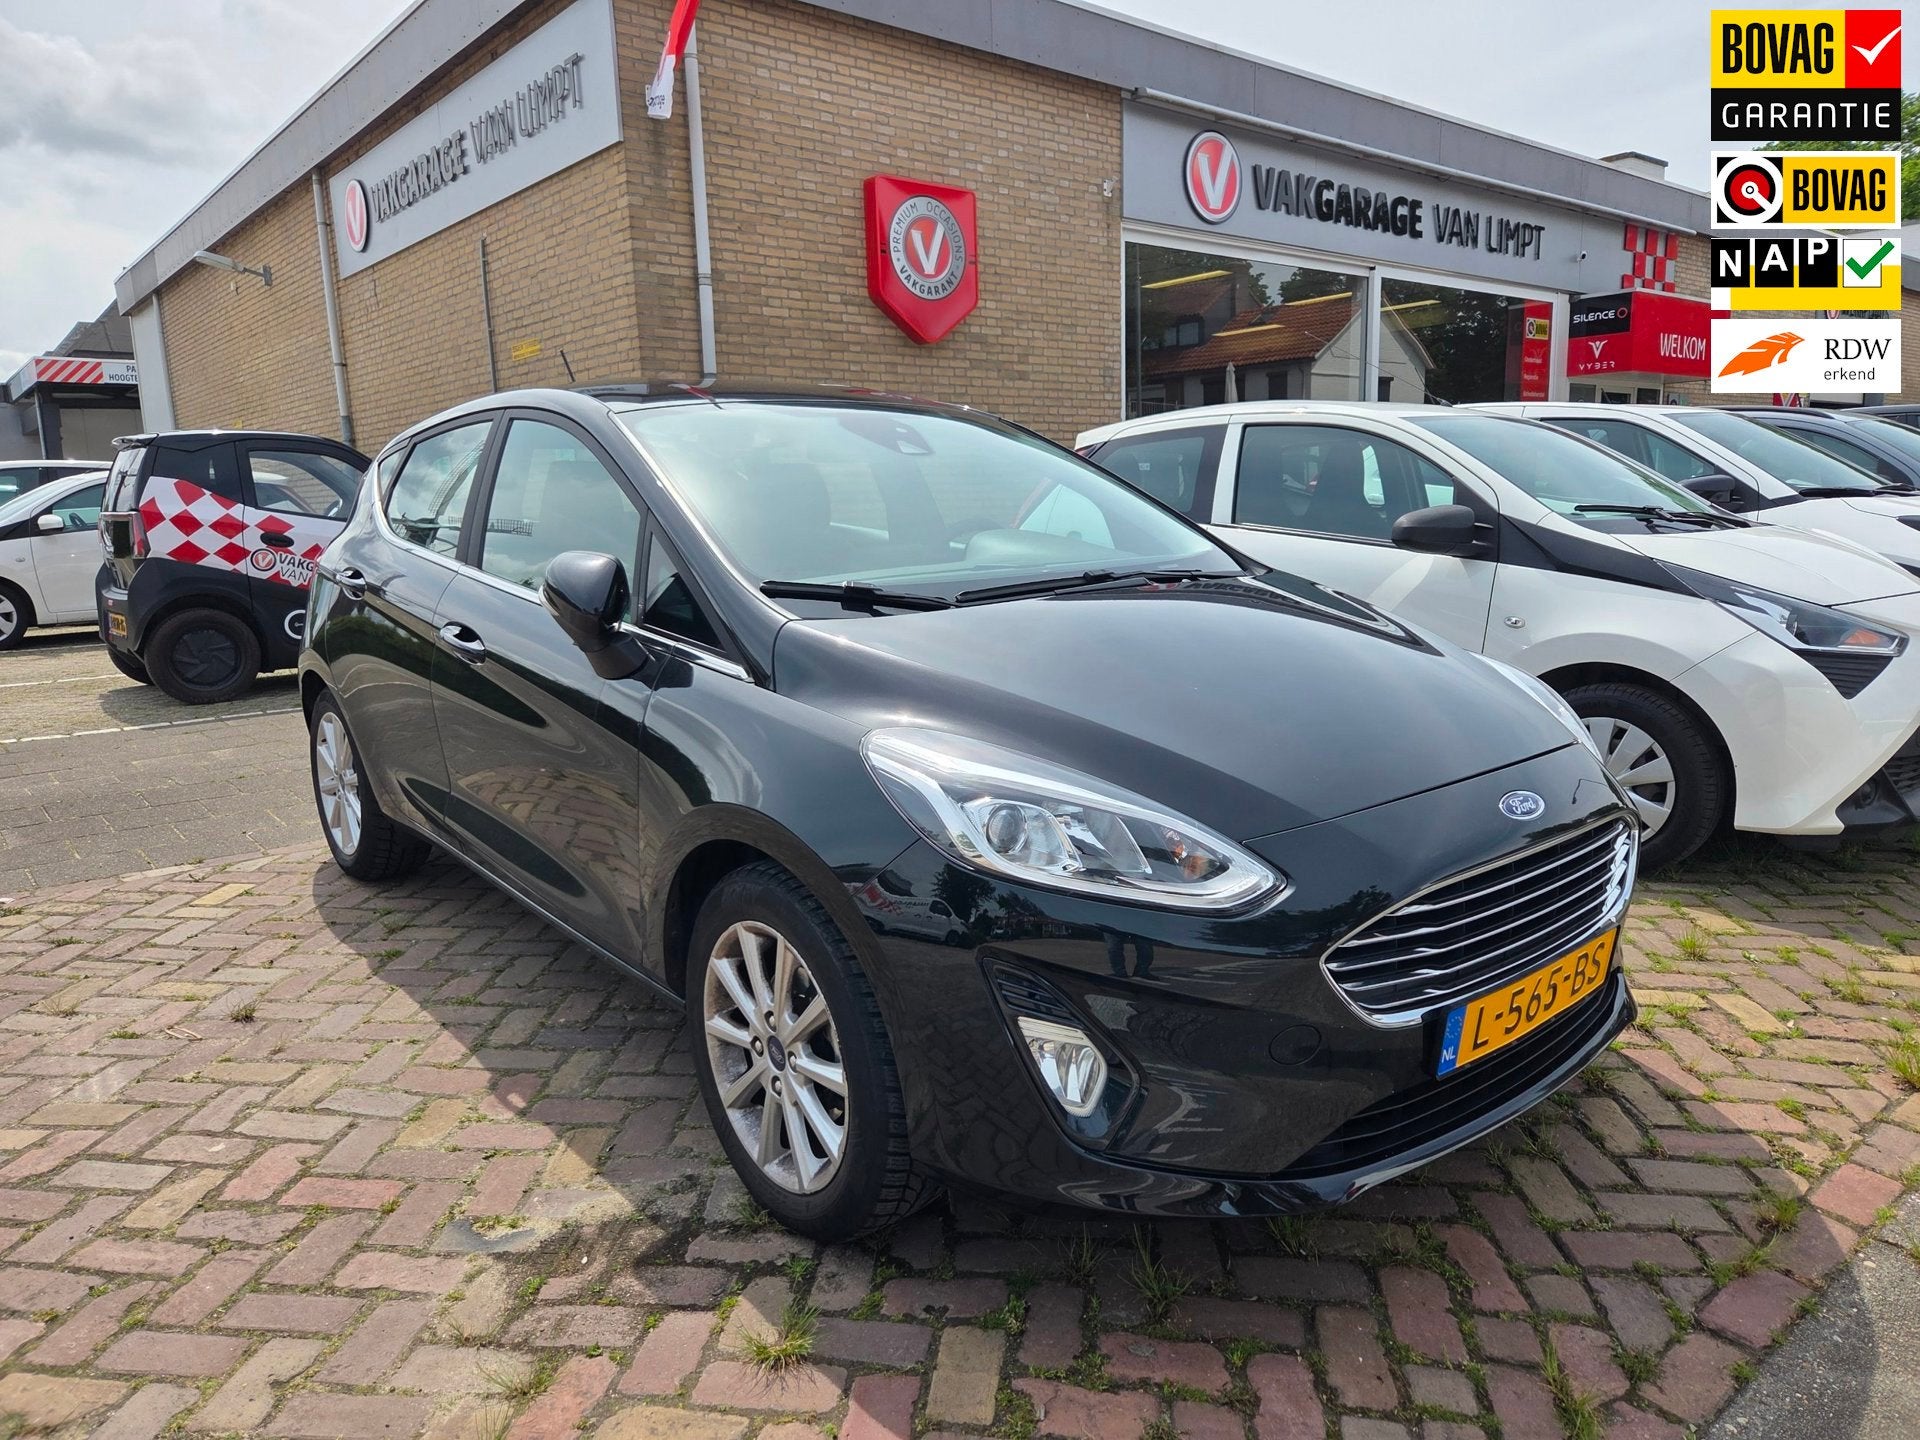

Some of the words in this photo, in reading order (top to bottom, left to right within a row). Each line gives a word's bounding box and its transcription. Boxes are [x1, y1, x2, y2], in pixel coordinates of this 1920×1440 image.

[370, 129, 468, 223] VAKGARAGE
[469, 99, 515, 164] VAN
[515, 52, 585, 138] LIMPT
[1252, 163, 1424, 239] VAKGARAGE
[1432, 203, 1480, 249] VAN
[1485, 214, 1546, 261] LIMPT
[893, 201, 919, 254] PREMIUM
[926, 201, 964, 262] OCCASIONS
[900, 264, 959, 296] VAKGARANT
[1572, 309, 1616, 324] SILENCE
[1660, 332, 1707, 361] WELKOM
[1578, 360, 1616, 371] VYBER
[279, 553, 314, 572] VAKG
[280, 566, 309, 583] VAN
[1509, 797, 1537, 815] Ford
[1471, 941, 1606, 1052] L-565-BS
[1441, 1046, 1457, 1064] NL
